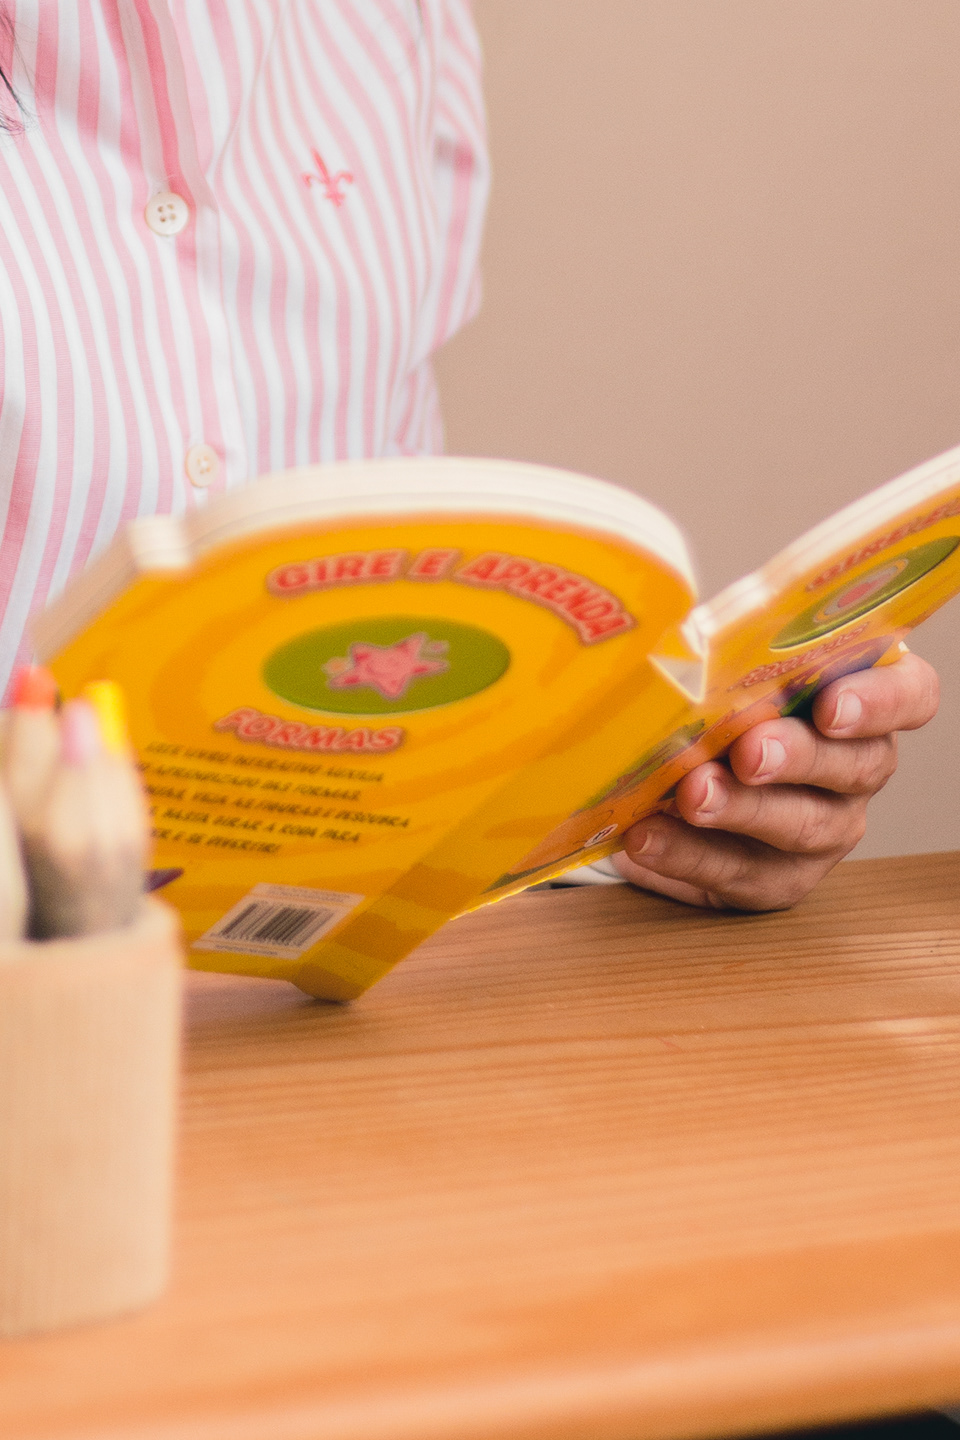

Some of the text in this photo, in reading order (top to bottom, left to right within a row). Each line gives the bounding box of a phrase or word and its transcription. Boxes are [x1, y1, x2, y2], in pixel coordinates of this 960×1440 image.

[267, 549, 638, 645] GIRE E APRENDA
[214, 708, 405, 753] FORMAS
